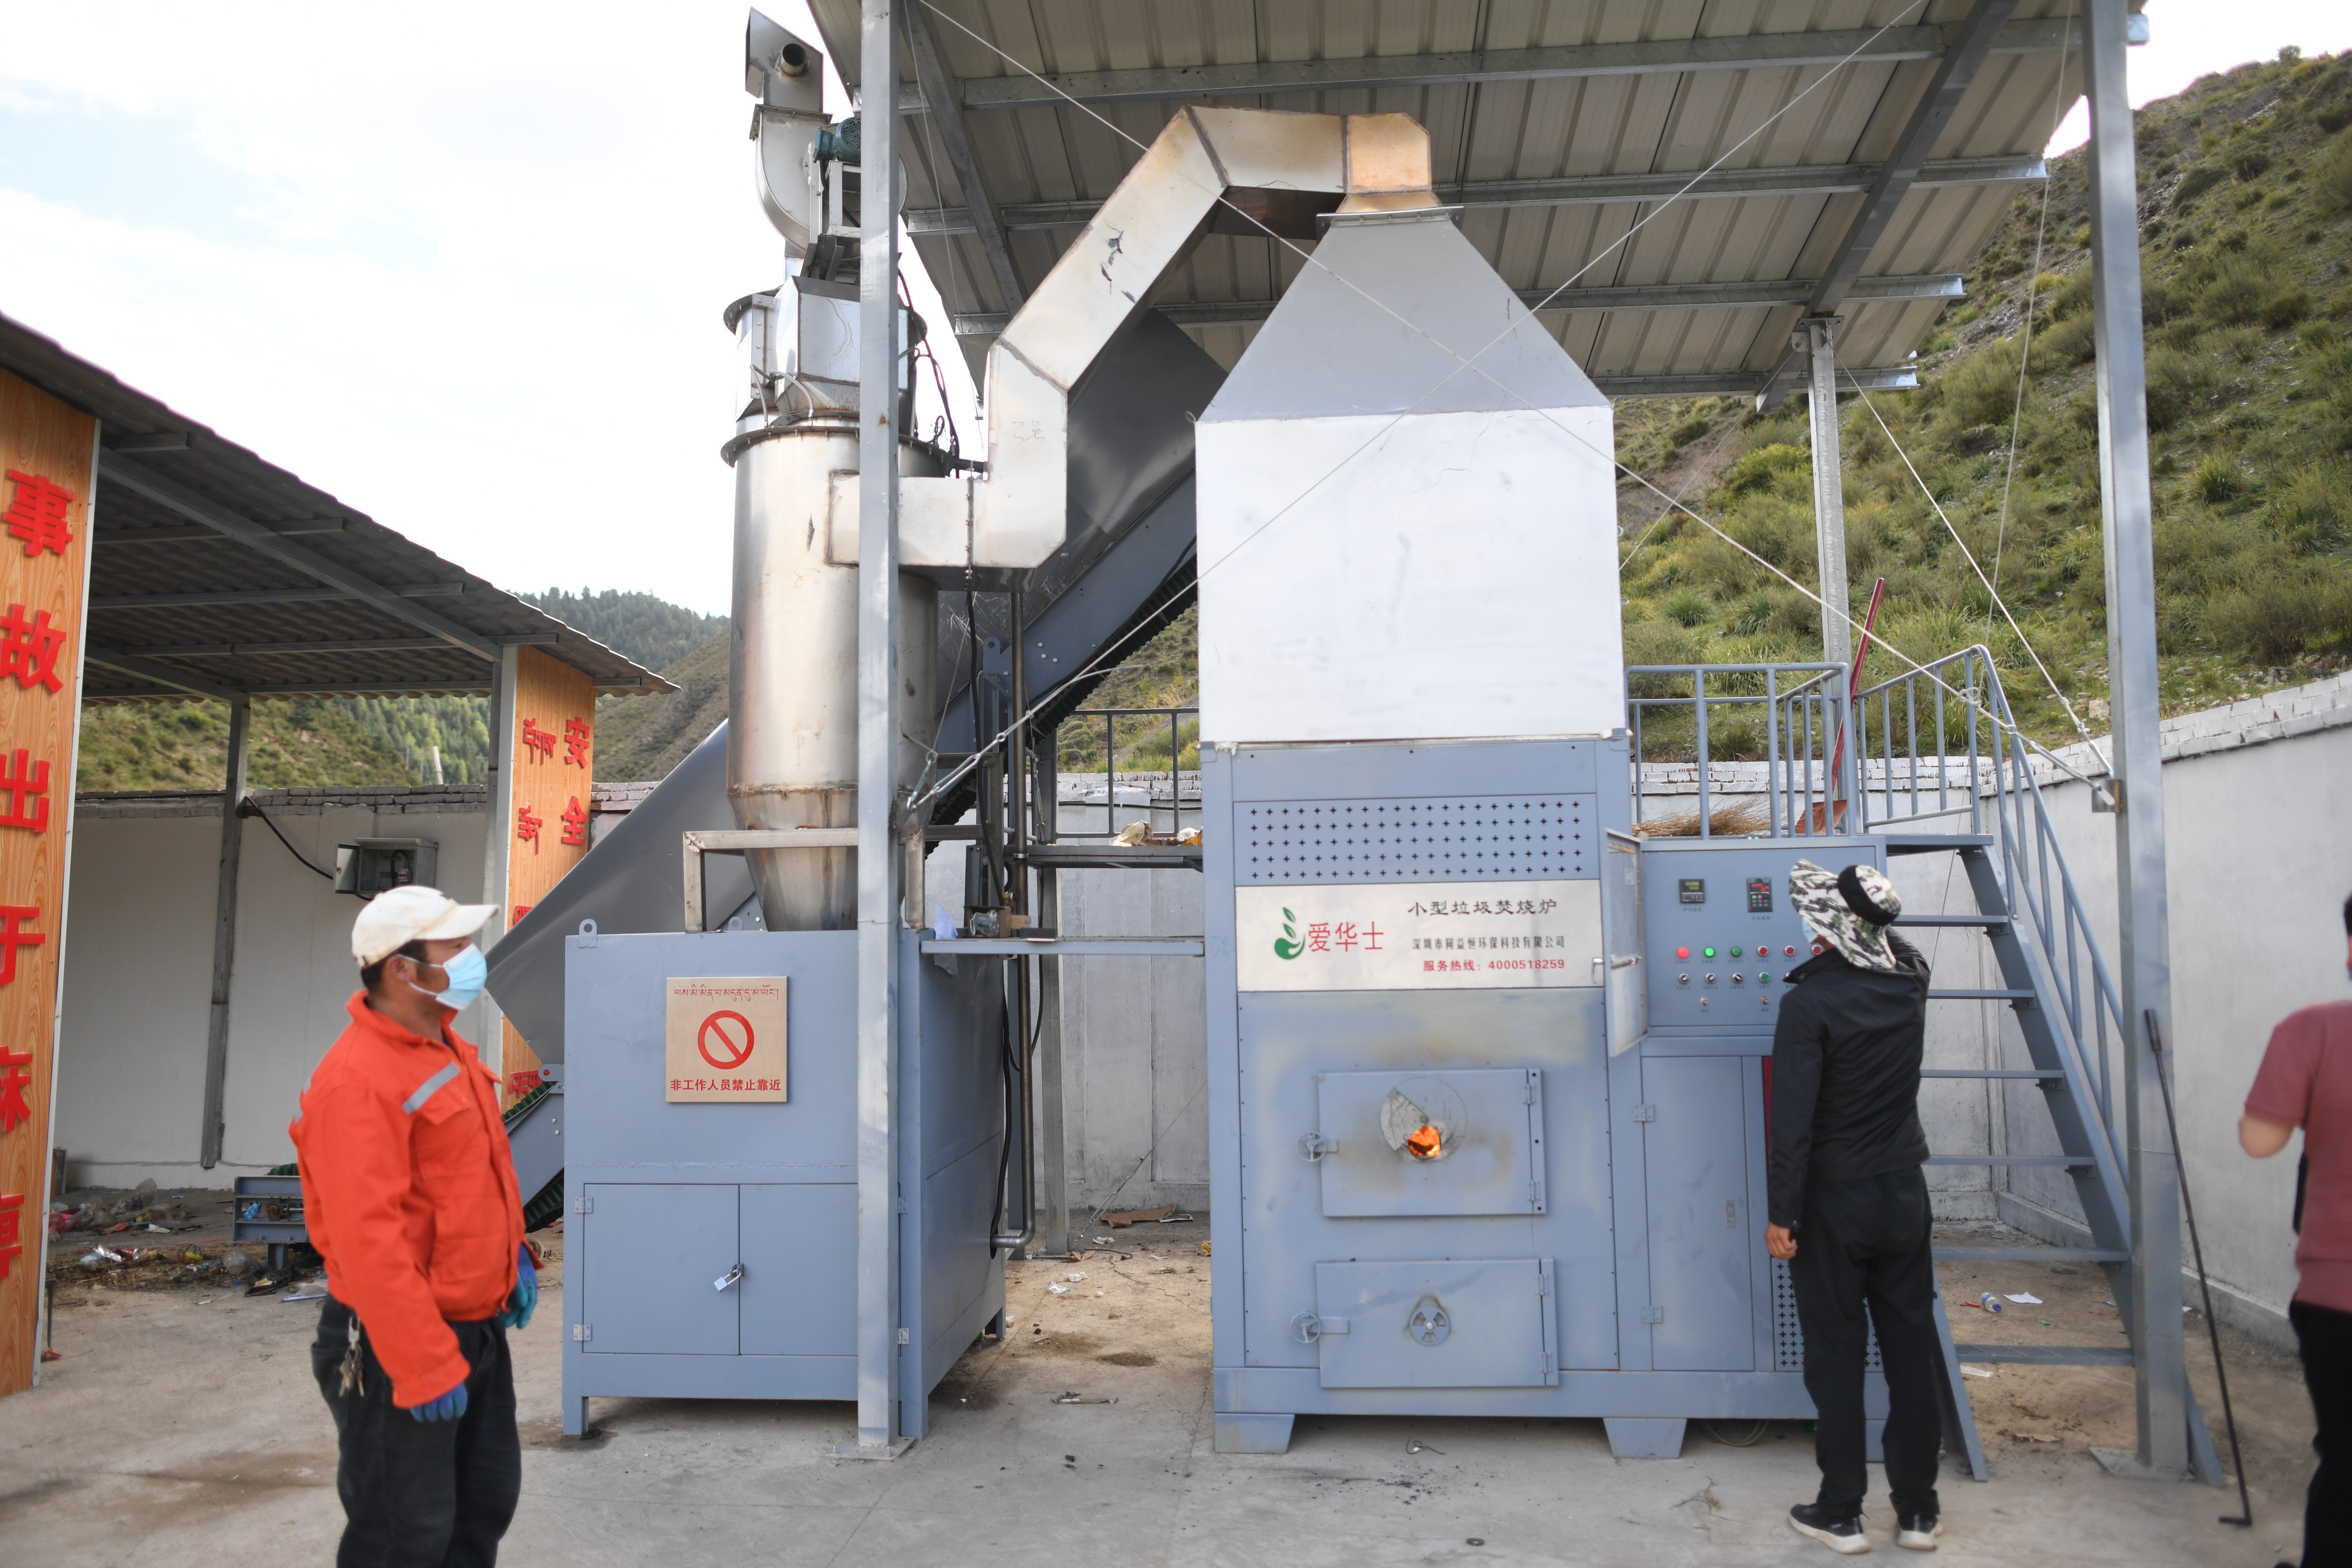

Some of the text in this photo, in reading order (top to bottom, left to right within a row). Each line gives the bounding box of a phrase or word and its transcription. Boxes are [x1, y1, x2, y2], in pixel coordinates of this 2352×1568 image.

[1407, 898, 1557, 916] 小型垃圾焚烧炉
[1308, 921, 1384, 953] 爱华士
[1412, 935, 1565, 950] 深圳市同益恒环保科技有限公司
[670, 1078, 781, 1092] 非工作人员禁止靠近
